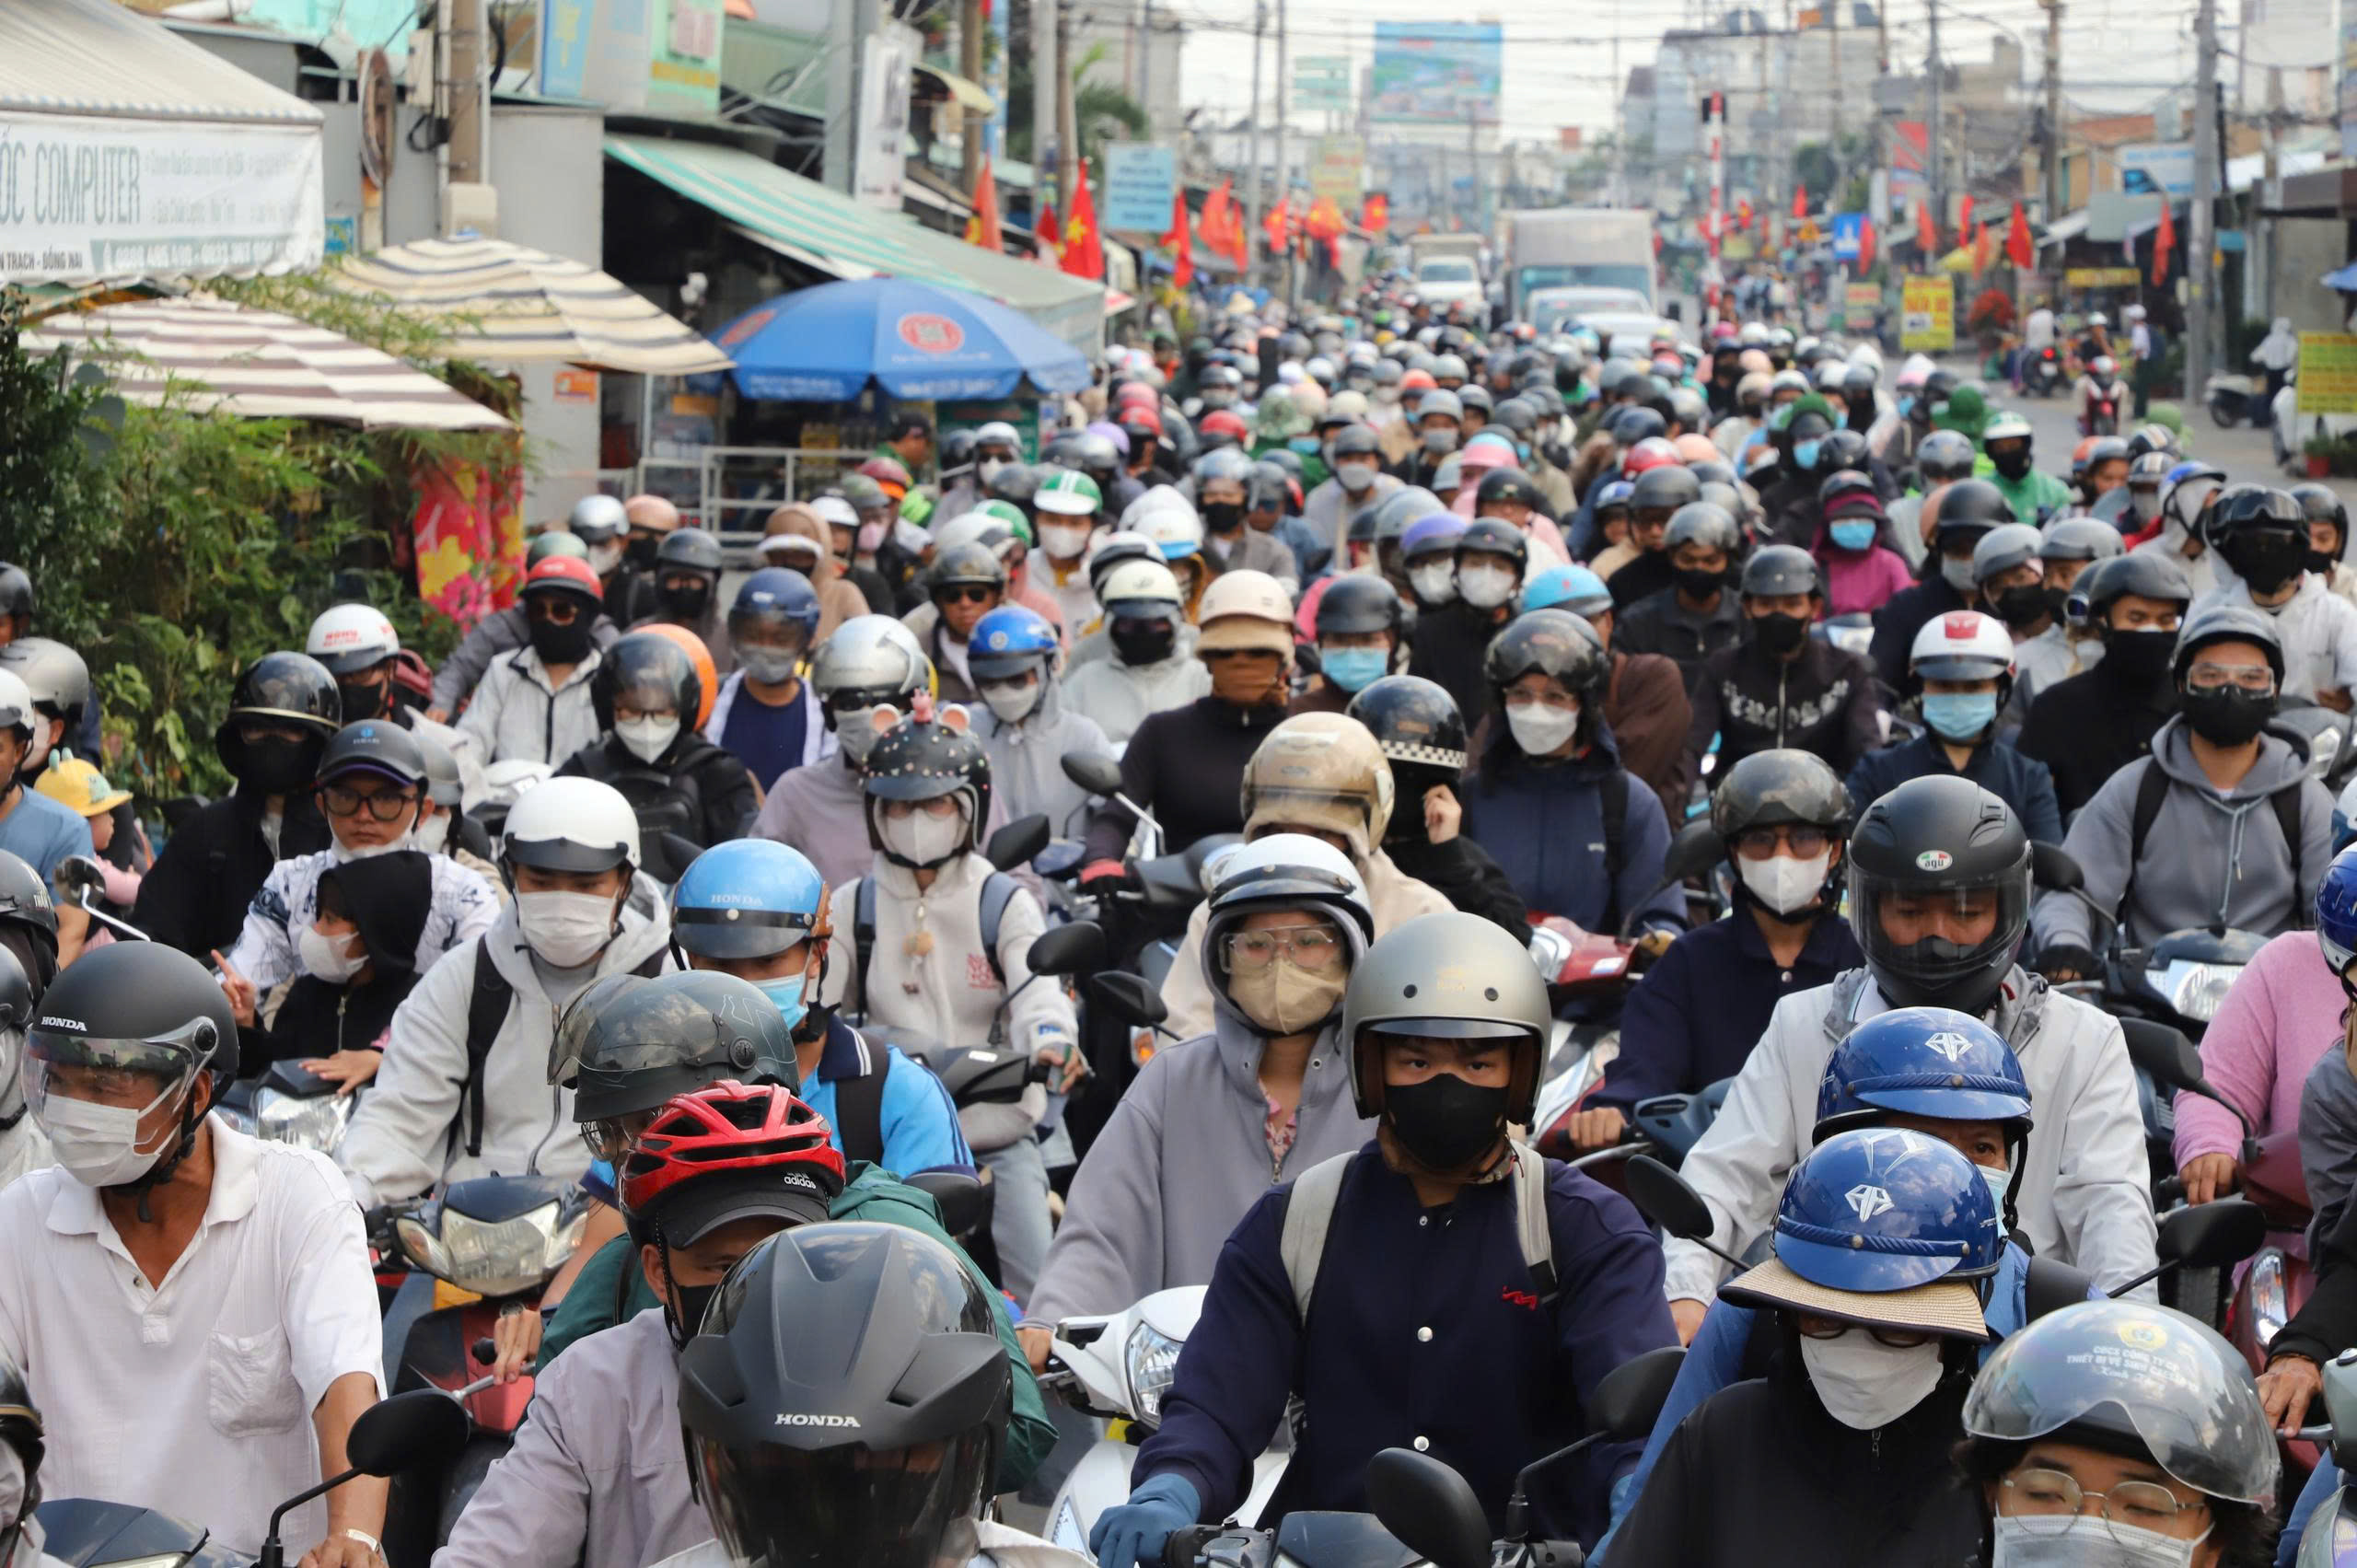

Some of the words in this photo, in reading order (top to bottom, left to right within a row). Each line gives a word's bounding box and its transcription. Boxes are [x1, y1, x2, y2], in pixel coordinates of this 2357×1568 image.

[35, 142, 140, 225] COMPUTER
[710, 894, 764, 907] HONDA
[41, 1016, 87, 1032] HONDA
[784, 1176, 817, 1190] adidas
[773, 1413, 862, 1428] HONDA
